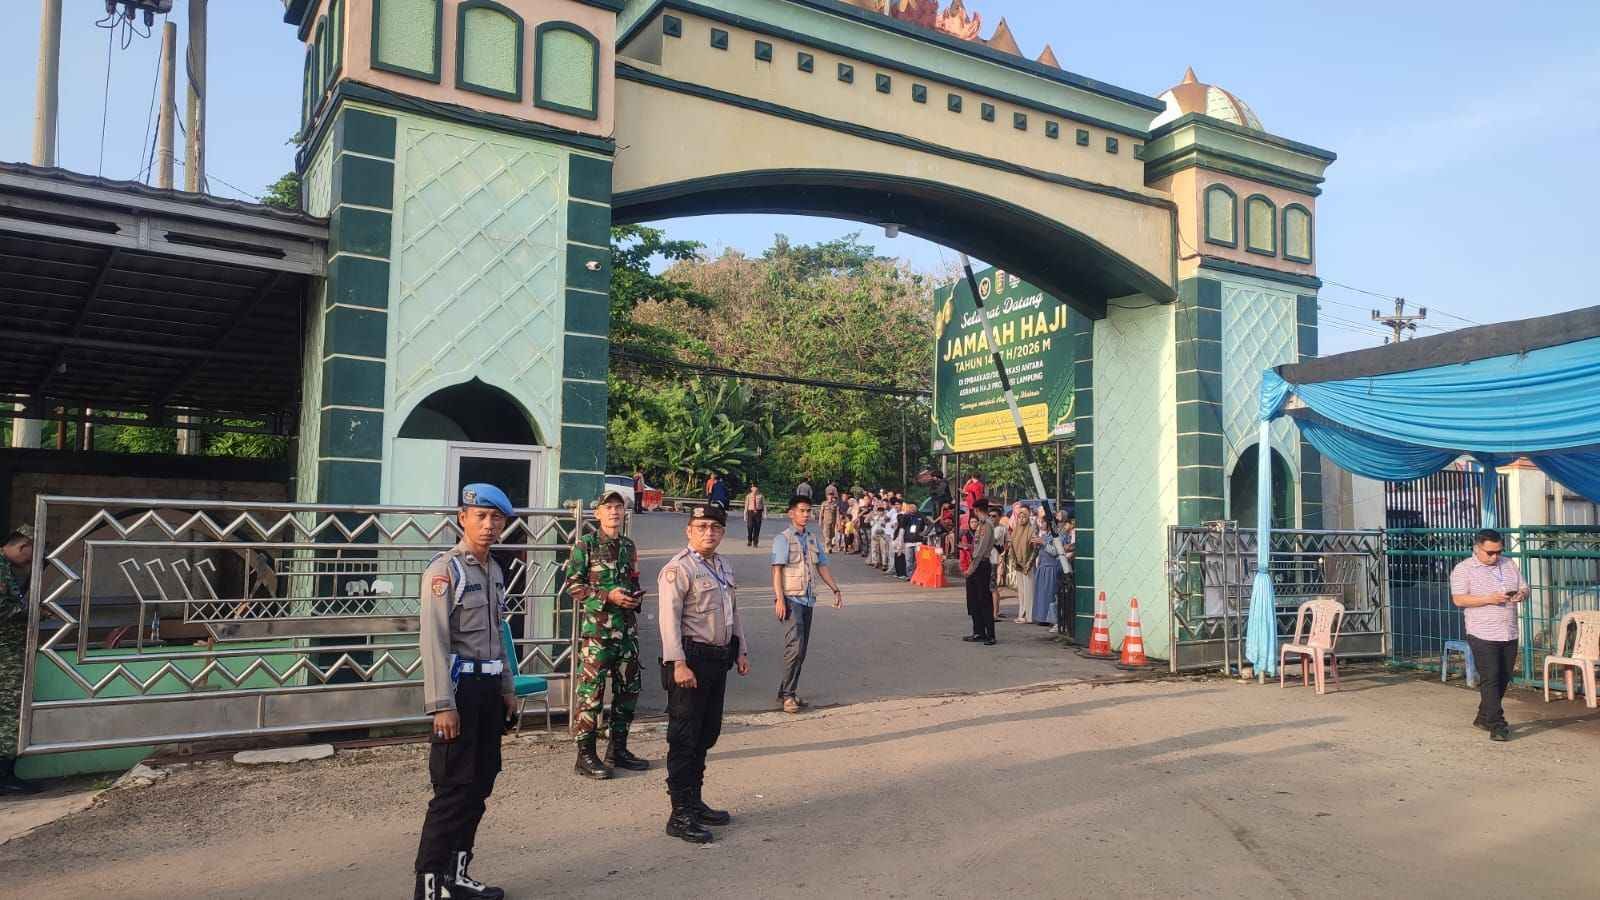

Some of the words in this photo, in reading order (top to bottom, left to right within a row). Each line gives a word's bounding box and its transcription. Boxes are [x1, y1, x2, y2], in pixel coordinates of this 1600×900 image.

[1002, 293, 1043, 314] Datang
[943, 321, 1015, 361] JAMAAH
[1021, 304, 1067, 340] HAJI
[955, 357, 982, 373] TAHUN
[985, 350, 1005, 366] 147
[1006, 341, 1040, 360] H/2026
[1042, 338, 1051, 352] M
[1021, 359, 1044, 373] ANTARA
[1017, 372, 1044, 385] LAMPUNG
